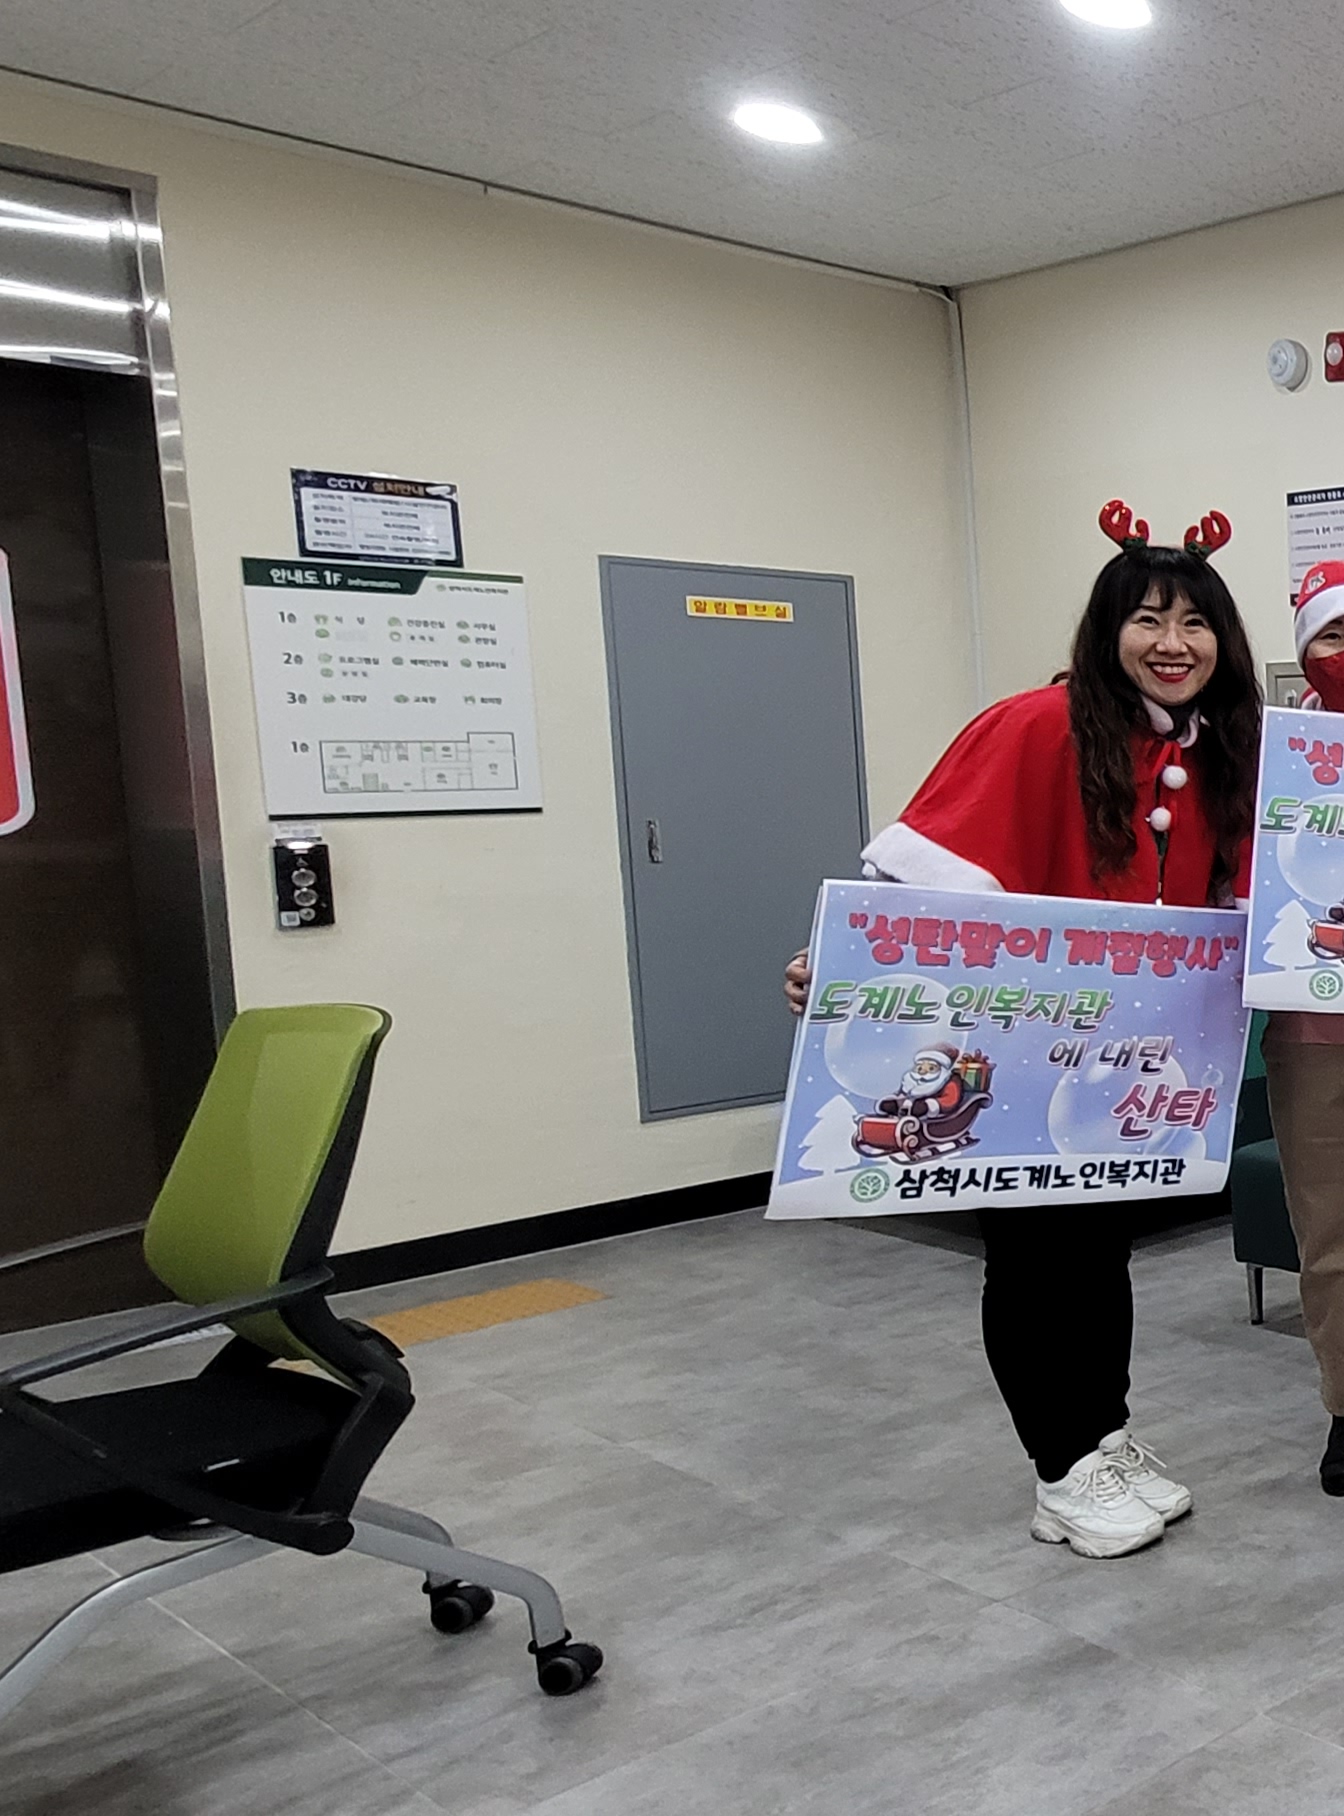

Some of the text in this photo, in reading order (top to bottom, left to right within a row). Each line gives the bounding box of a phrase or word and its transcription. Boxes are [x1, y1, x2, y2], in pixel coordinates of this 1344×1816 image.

[327, 477, 424, 496] CCTV 설치안내
[270, 568, 320, 584] 안내도
[323, 570, 343, 586] 1F
[808, 979, 1114, 1032] 도계노인복지관
[1047, 1035, 1174, 1075] 에 내린
[1110, 1081, 1217, 1141] 산타
[894, 1158, 1188, 1199] 삼척시도계노인복지관
